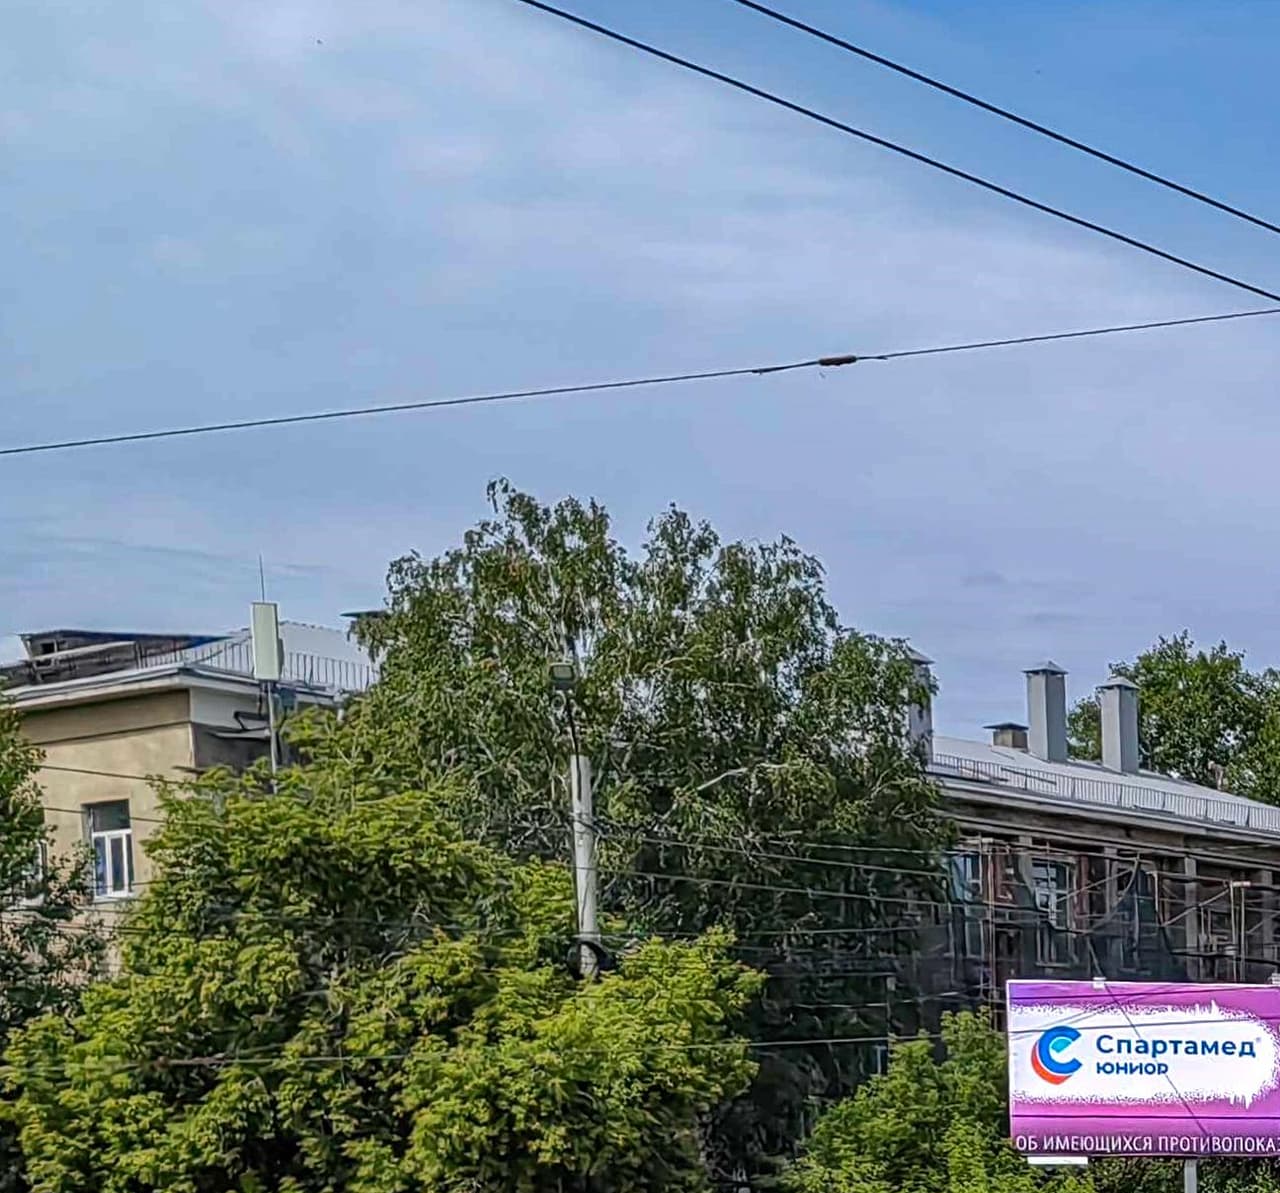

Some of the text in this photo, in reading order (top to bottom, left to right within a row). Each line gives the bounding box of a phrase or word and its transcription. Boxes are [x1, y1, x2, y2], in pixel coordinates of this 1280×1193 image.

[1096, 1034, 1256, 1059] Спартамед
[1016, 1135, 1038, 1151] ОБ
[1044, 1135, 1153, 1153] ИМЕЮЩИХСЯ
